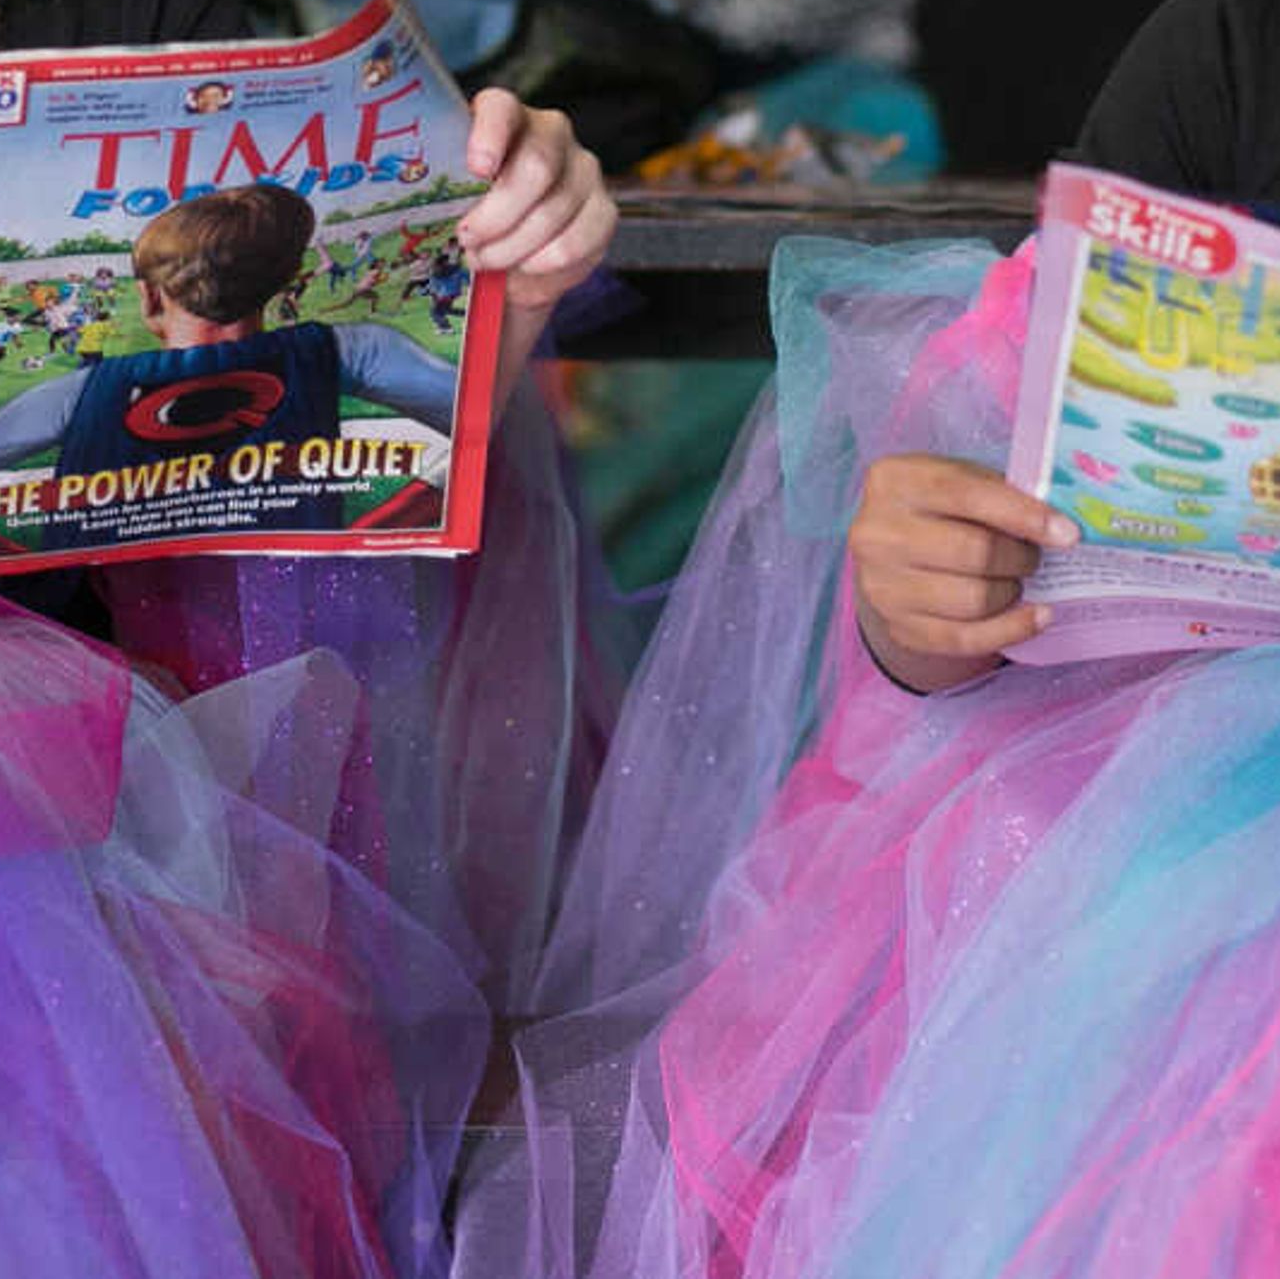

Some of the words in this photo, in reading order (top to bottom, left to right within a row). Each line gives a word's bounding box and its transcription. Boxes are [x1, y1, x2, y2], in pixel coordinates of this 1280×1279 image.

[61, 77, 424, 202] TIME
[1086, 203, 1212, 270] Skills
[53, 510, 87, 522] kids
[91, 507, 119, 518] can
[249, 485, 264, 495] in
[267, 485, 277, 495] a
[280, 482, 321, 497] noisy
[58, 453, 215, 513] POWER
[230, 441, 286, 484] OF
[298, 436, 429, 477] QUIET
[262, 497, 299, 512] your
